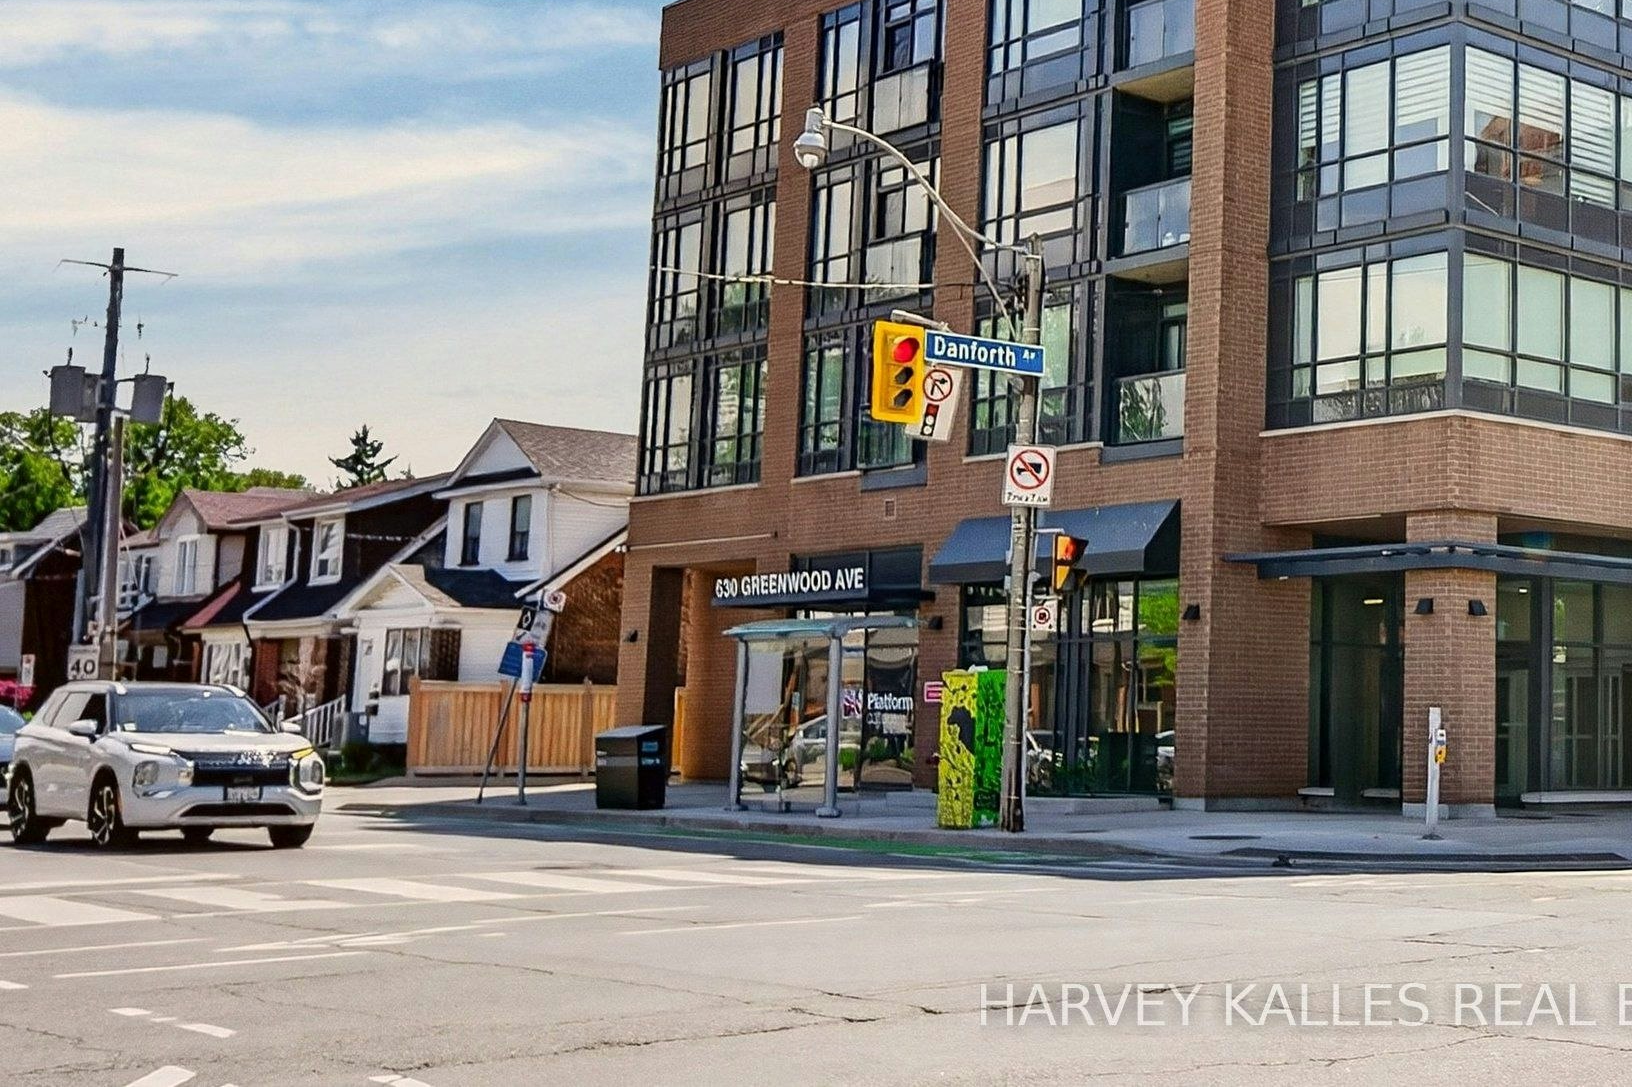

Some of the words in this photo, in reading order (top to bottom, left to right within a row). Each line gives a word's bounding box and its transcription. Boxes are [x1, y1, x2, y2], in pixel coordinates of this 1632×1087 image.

[934, 335, 1016, 367] Danforth
[715, 577, 738, 599] 630
[741, 569, 831, 597] GREENWOOD
[835, 567, 864, 591] AVE
[70, 659, 96, 675] 40
[867, 692, 914, 711] Platform
